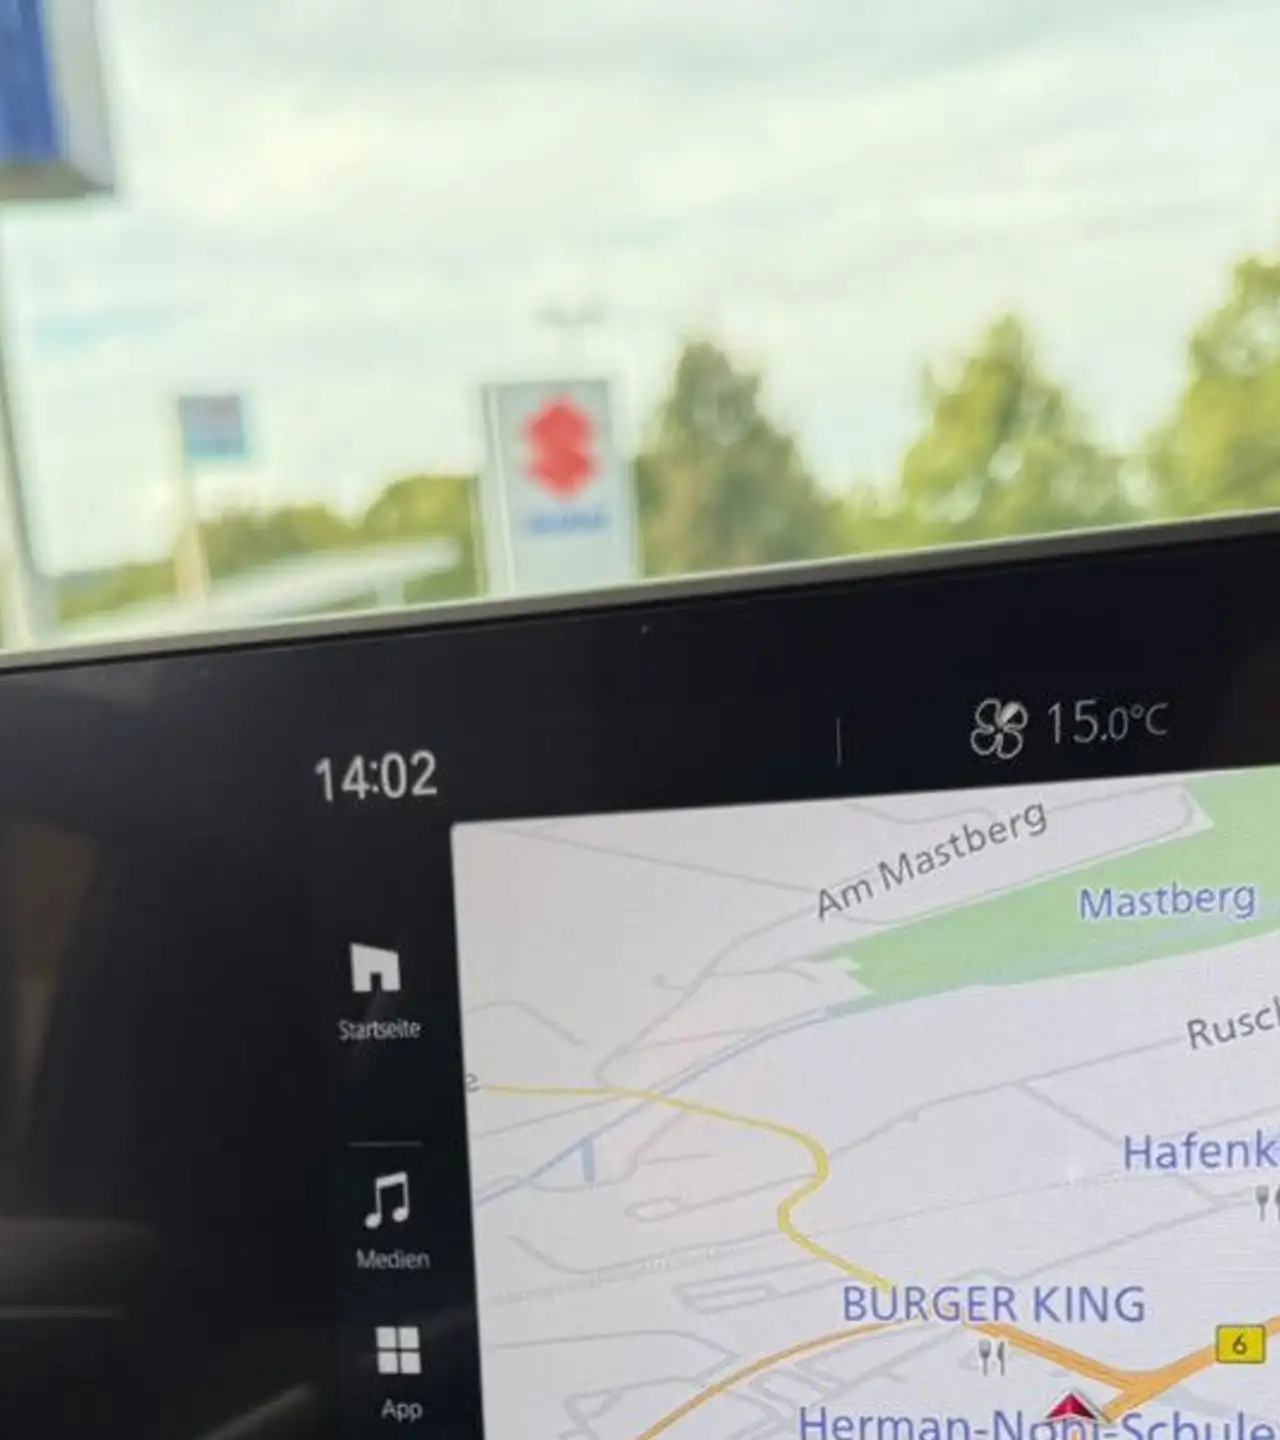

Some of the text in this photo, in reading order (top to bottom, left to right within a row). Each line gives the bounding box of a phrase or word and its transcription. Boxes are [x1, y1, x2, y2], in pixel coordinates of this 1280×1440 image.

[1048, 698, 1169, 743] 15.0°C
[315, 749, 438, 801] 14:02
[817, 800, 1048, 920] Am Mastberg
[1078, 879, 1258, 921] Mastberg
[337, 1019, 422, 1042] Startseite
[356, 1247, 431, 1270] Medien
[842, 1284, 1146, 1324] BURGER KING
[1231, 1333, 1247, 1356] 6
[381, 1398, 424, 1423] App
